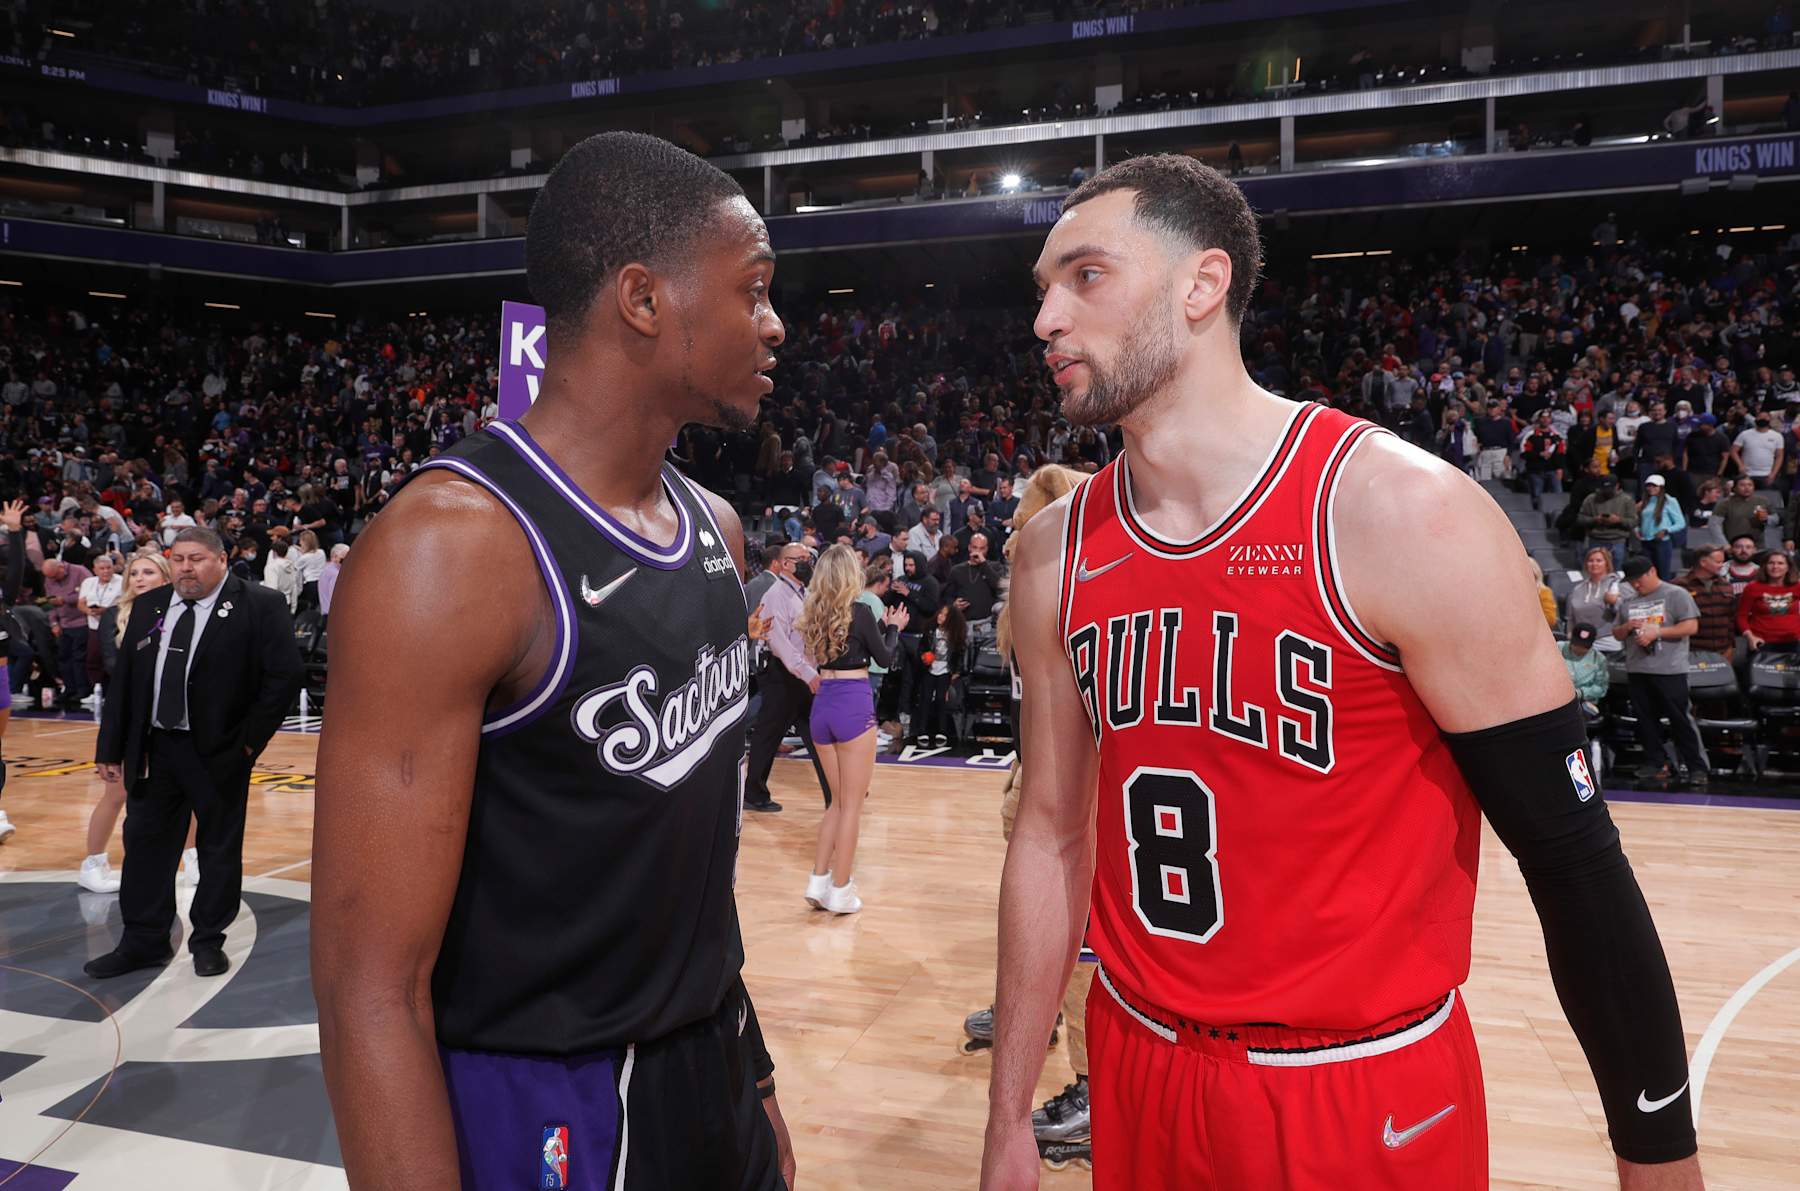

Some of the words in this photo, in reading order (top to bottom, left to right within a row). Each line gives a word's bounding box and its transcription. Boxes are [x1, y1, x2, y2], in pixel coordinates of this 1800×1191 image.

[1072, 19, 1104, 39] KINGS
[1106, 16, 1128, 35] WIN
[68, 69, 85, 80] PM
[207, 88, 239, 109] KINGS
[241, 95, 261, 112] WIN
[571, 80, 597, 99] KINGS
[598, 78, 615, 96] WIN
[1696, 143, 1751, 173] KINGS
[1756, 140, 1795, 169] WIN
[1023, 199, 1063, 225] KINGS
[1229, 543, 1303, 561] ZENNI
[1226, 566, 1302, 575] EYEWEAR
[1069, 607, 1335, 774] BULLS
[1122, 765, 1224, 944] 8
